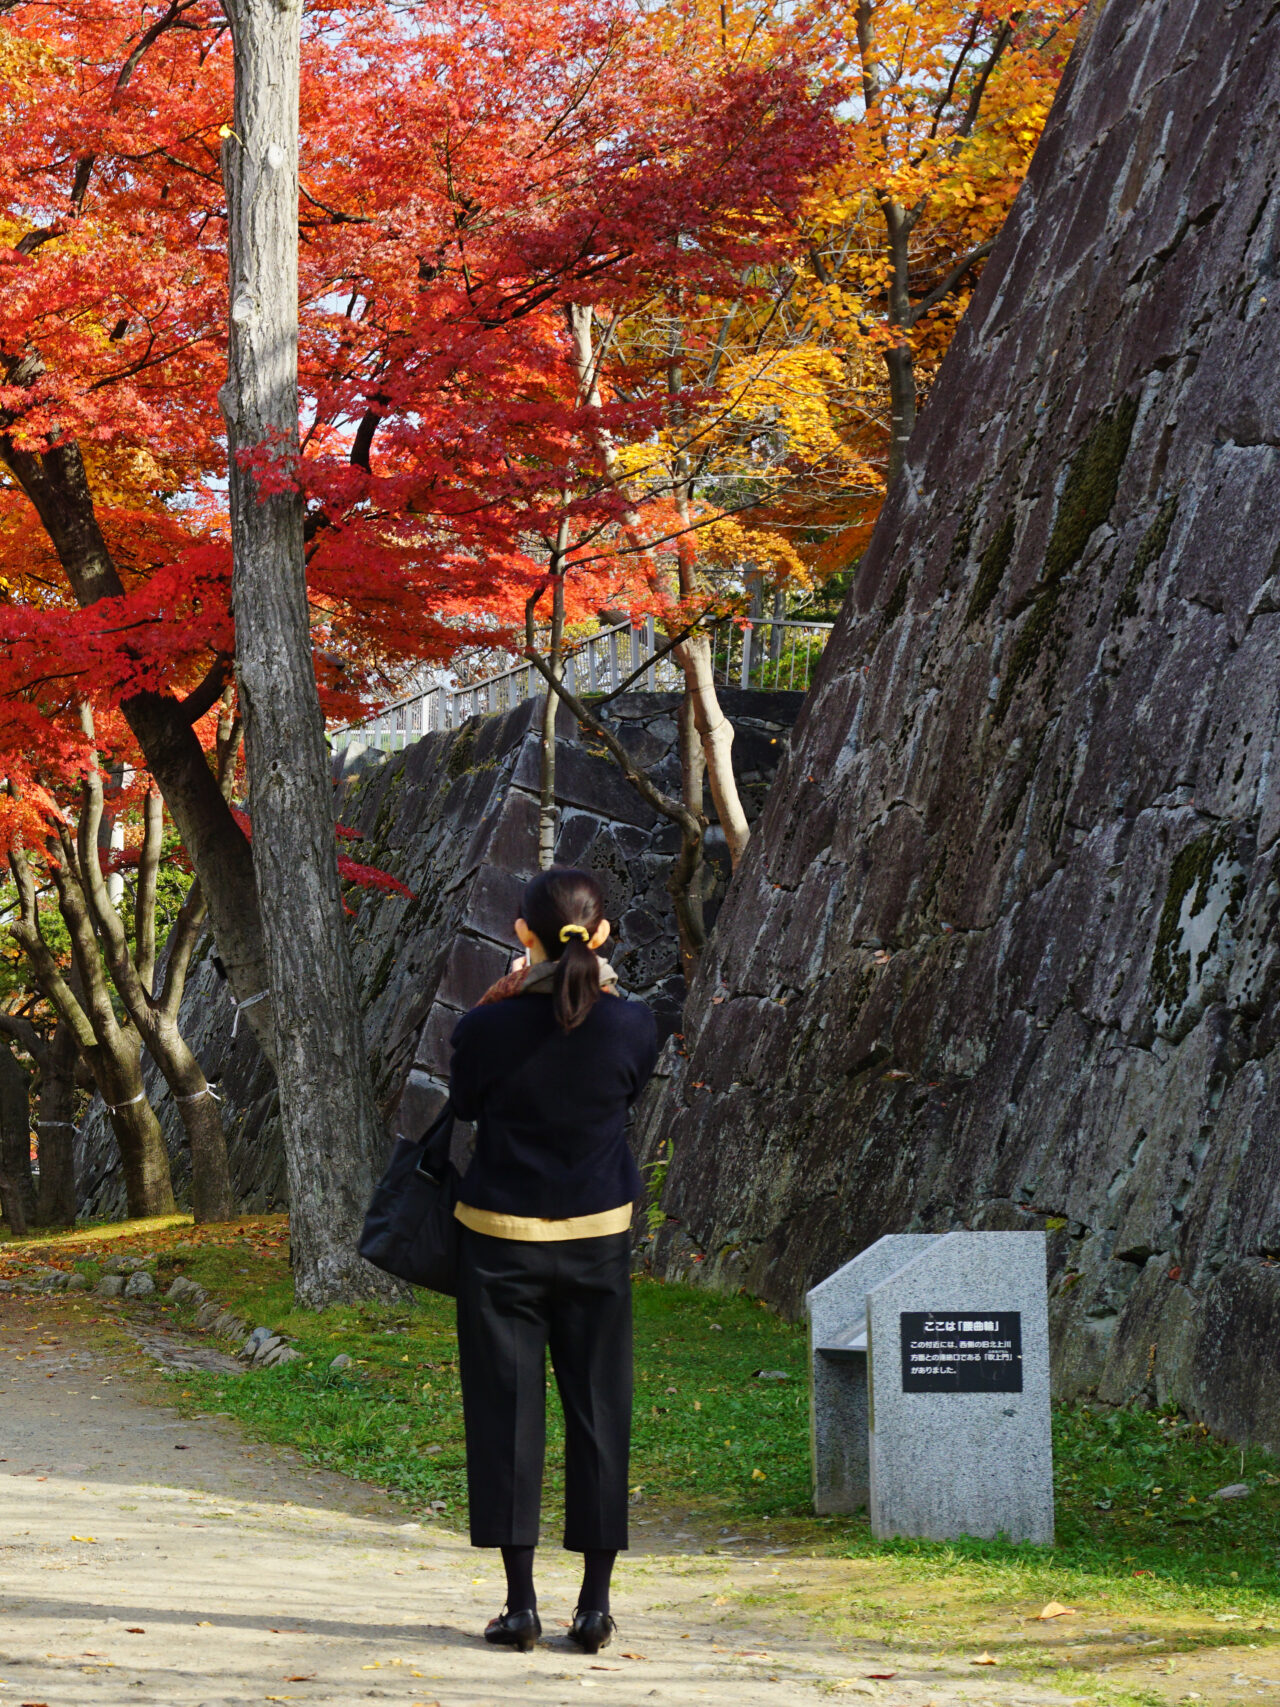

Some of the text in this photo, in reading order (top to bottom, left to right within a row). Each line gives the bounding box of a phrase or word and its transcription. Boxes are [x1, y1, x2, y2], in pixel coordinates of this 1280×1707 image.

[911, 1366, 956, 1374] がありました。
